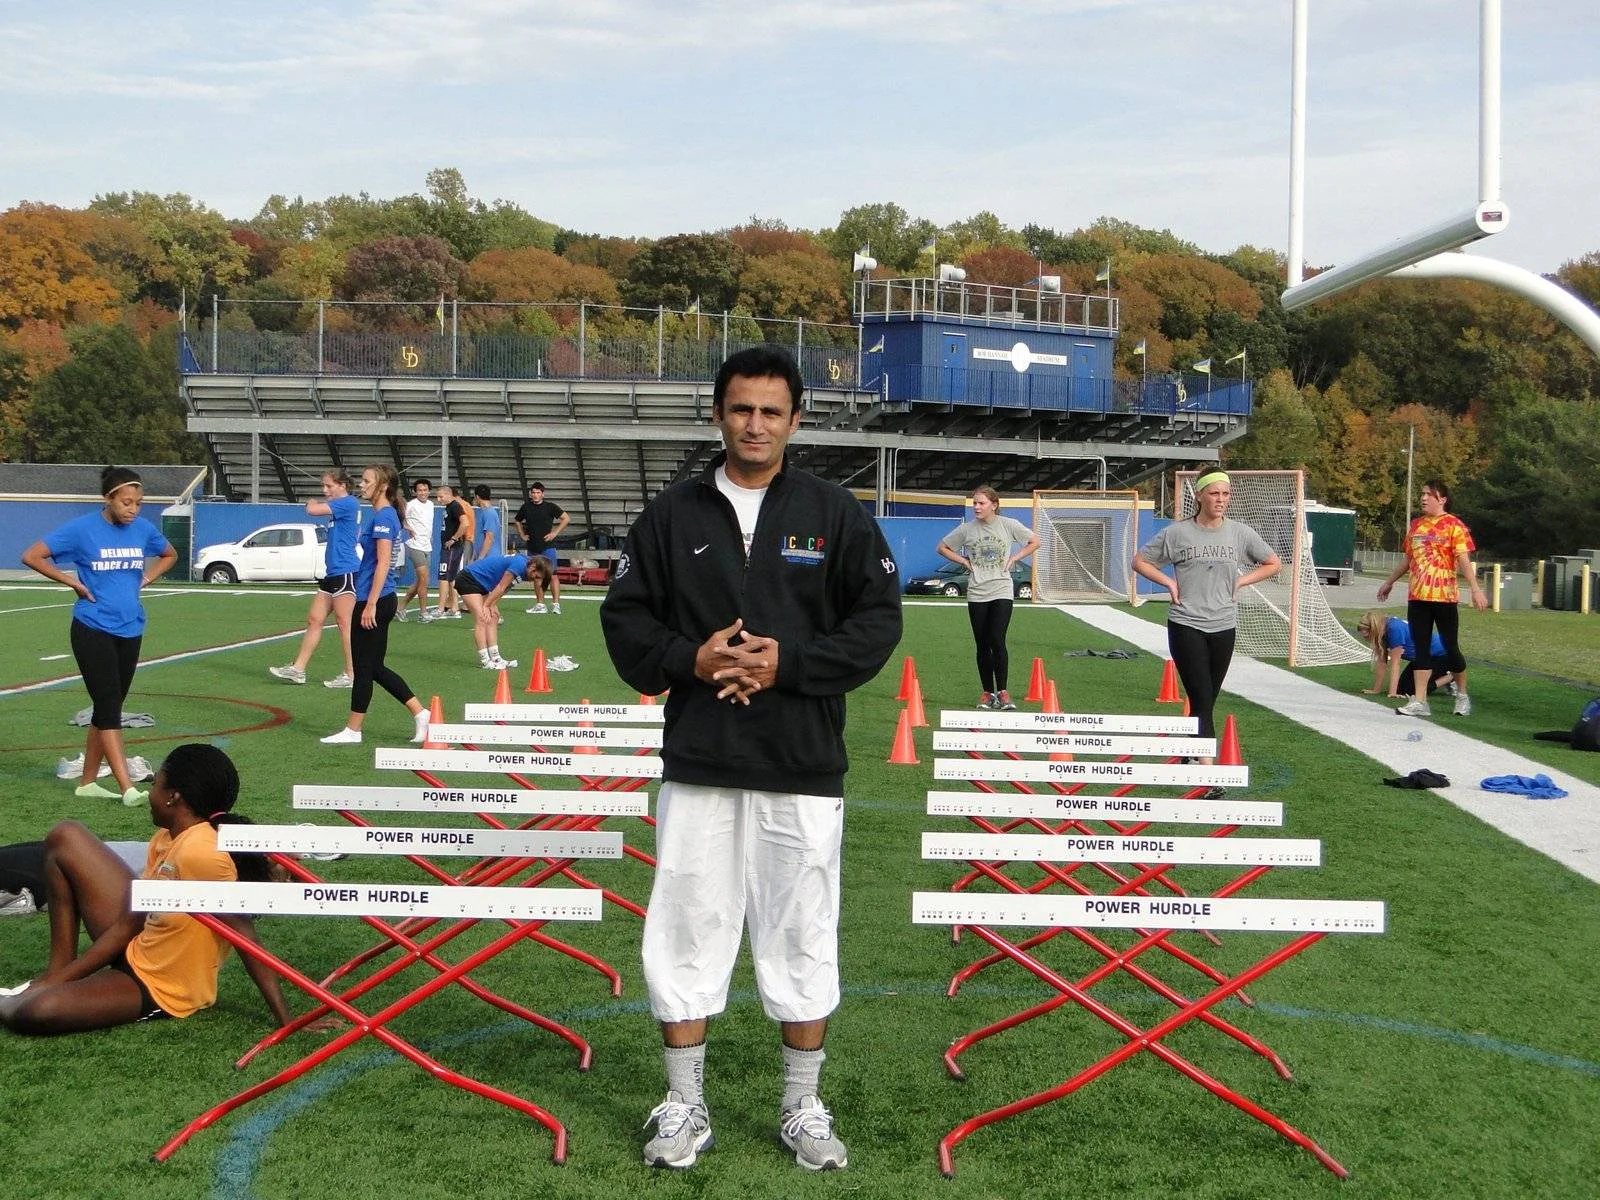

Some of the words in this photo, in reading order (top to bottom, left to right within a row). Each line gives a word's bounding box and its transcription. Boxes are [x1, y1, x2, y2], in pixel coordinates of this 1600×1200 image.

[1179, 545, 1237, 562] DELAWAR
[91, 560, 122, 571] TRACK
[558, 706, 590, 714] POWER
[594, 707, 628, 715] HURDLE
[1034, 715, 1065, 723] POWER
[1069, 716, 1104, 724] HURDLE
[530, 729, 564, 738] POWER
[569, 730, 606, 739] HURDLE
[1036, 737, 1070, 745] POWER
[1074, 738, 1112, 747] HURDLE
[488, 755, 525, 765] POWER
[530, 756, 572, 766] HURDLE
[1049, 765, 1086, 774] POWER
[1091, 765, 1133, 775] HURDLE
[422, 791, 465, 802] POWER
[471, 793, 518, 803] HURDLE
[1056, 799, 1098, 810] POWER
[1104, 801, 1151, 812] HURDLE
[366, 831, 414, 843] POWER
[421, 832, 474, 845] HURDLE
[1068, 839, 1114, 851] POWER
[1122, 840, 1174, 852] HURDLE
[304, 888, 359, 902] POWER
[368, 890, 429, 904] HURDLE
[1085, 900, 1140, 914] POWER
[1150, 902, 1211, 916] HURDLE
